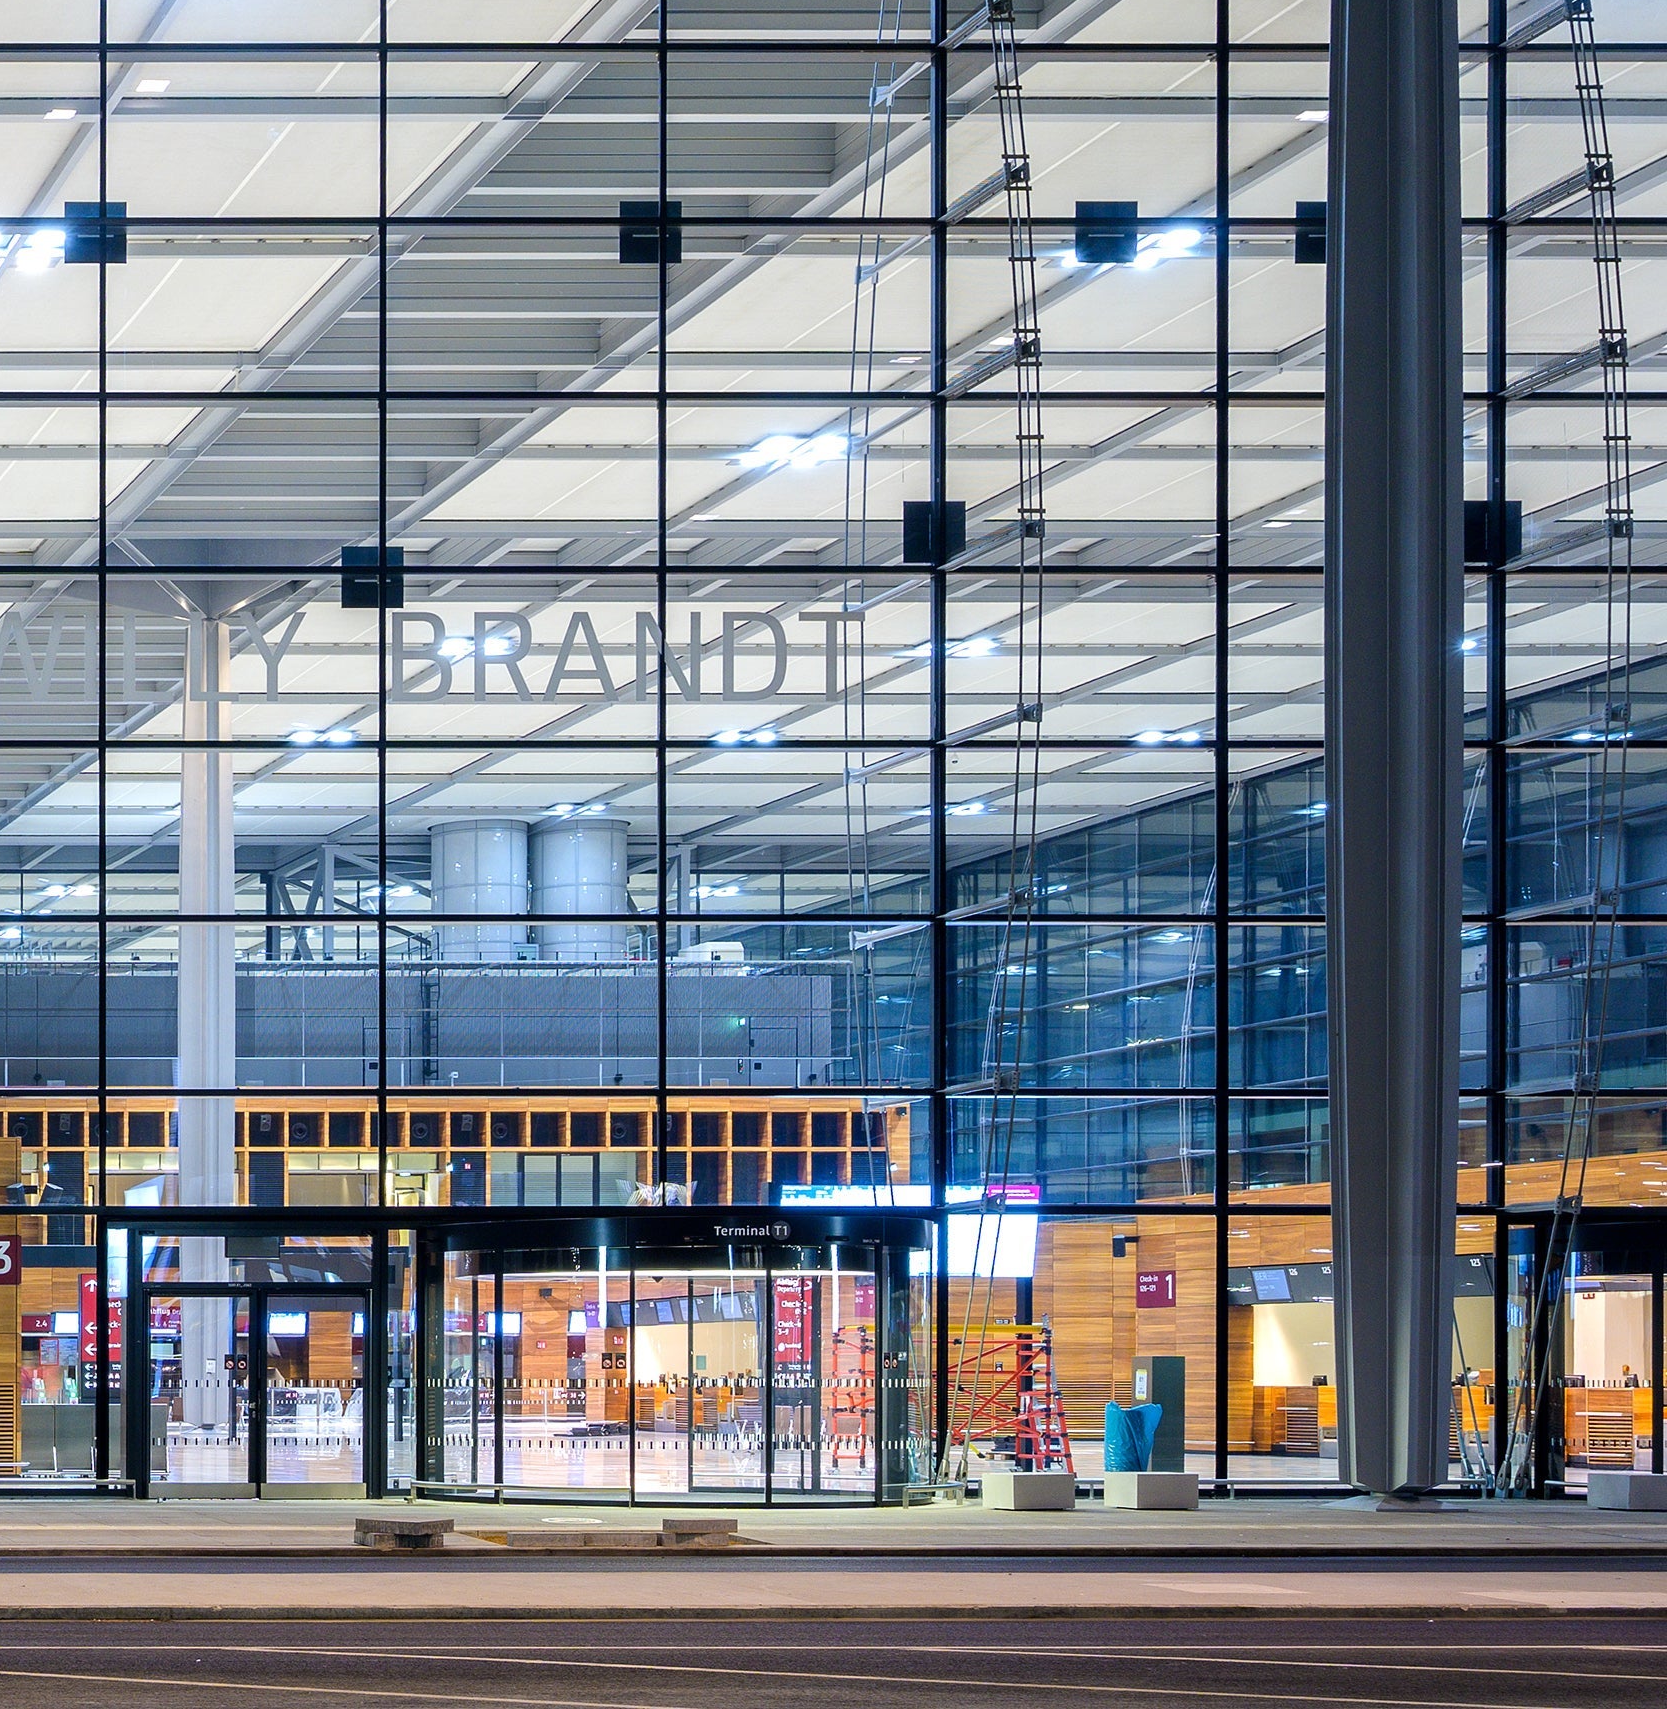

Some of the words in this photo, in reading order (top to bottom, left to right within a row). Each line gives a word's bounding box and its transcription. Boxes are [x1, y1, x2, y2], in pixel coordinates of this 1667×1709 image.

[391, 611, 866, 702] BRANDT
[714, 1225, 770, 1236] Terminal
[774, 1225, 788, 1236] T1
[1165, 1274, 1172, 1300] 1
[35, 1319, 48, 1327] 2.4
